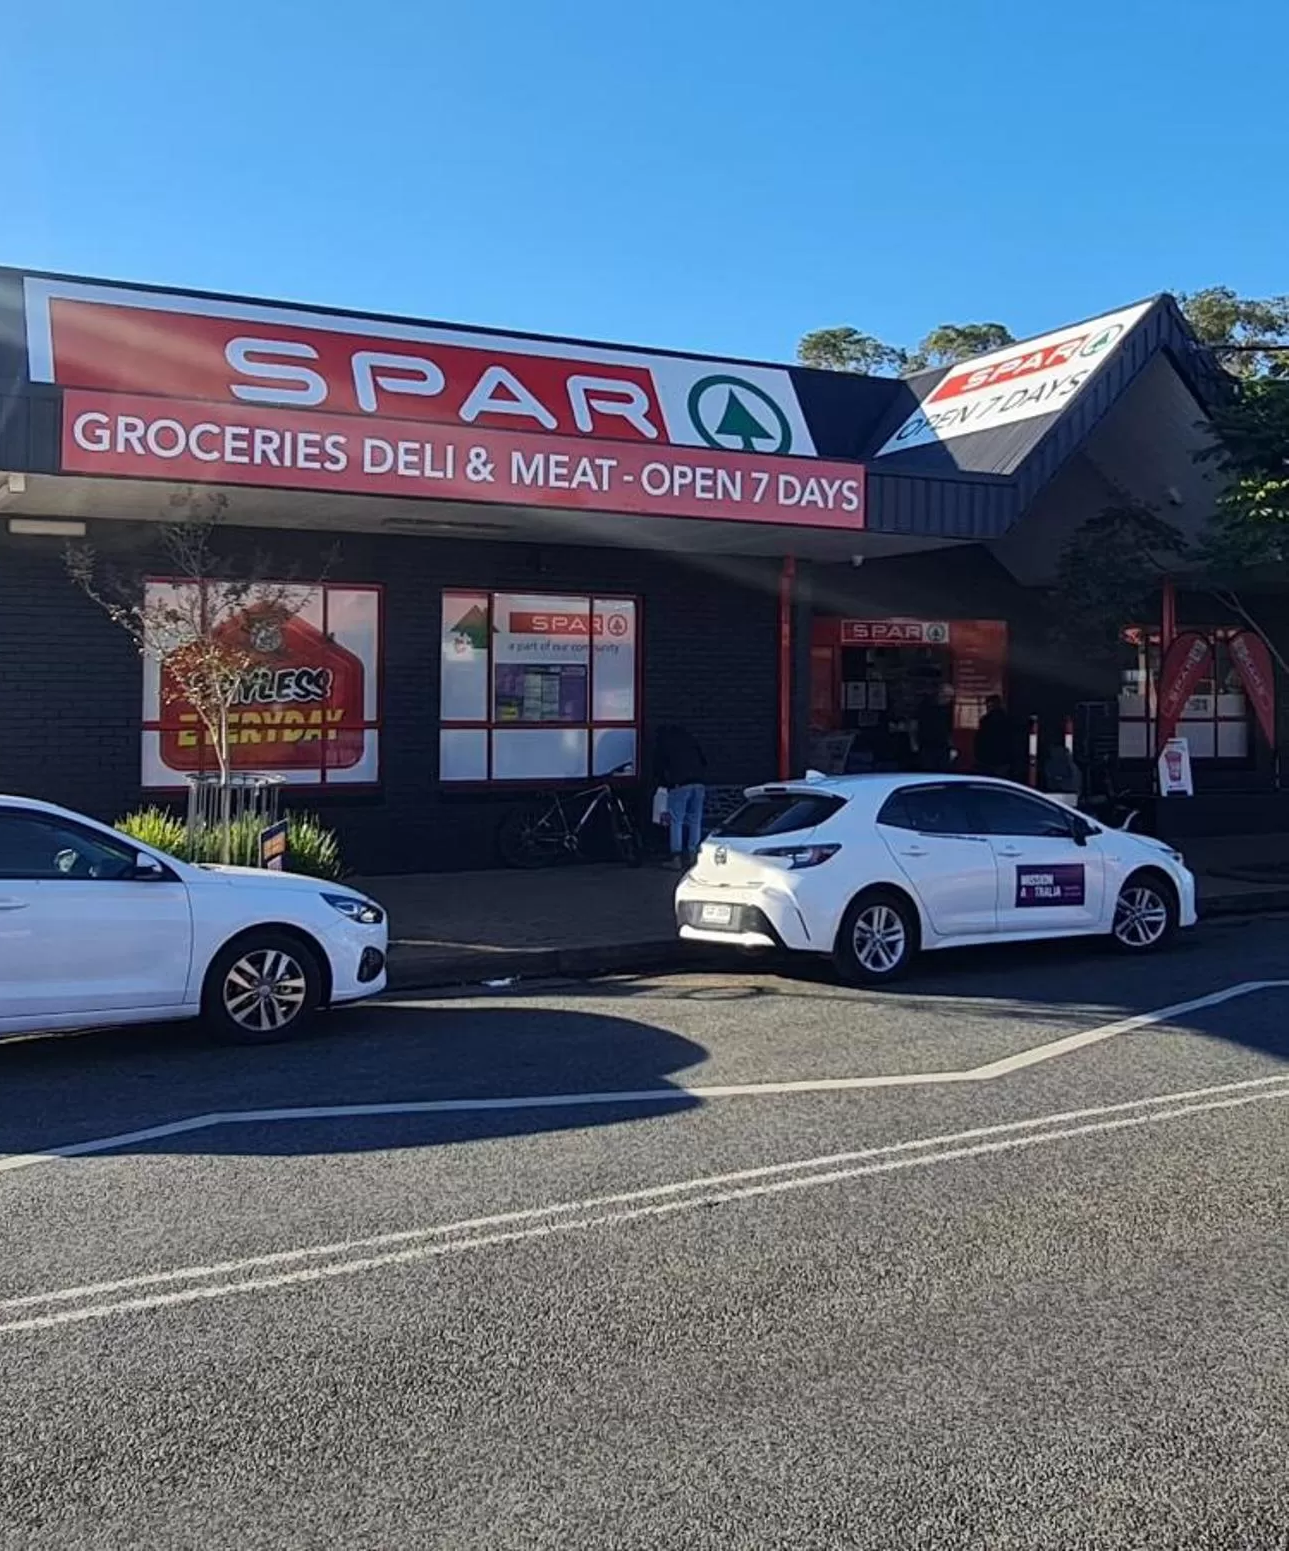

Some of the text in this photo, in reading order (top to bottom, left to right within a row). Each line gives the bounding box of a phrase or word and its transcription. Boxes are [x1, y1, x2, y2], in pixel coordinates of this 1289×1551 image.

[963, 338, 1084, 390] SPAR
[225, 336, 659, 440] SPAR
[896, 369, 1090, 441] OPEN 7 DAYS
[72, 411, 348, 471] GROCERIES
[362, 438, 454, 479] DELI
[465, 445, 495, 482] &
[511, 450, 617, 491] MEAT
[640, 462, 742, 502] OPEN
[750, 470, 770, 502] 7
[778, 475, 860, 511] DAYS
[532, 616, 602, 632] SPAR
[853, 624, 921, 638] SPAR
[517, 642, 539, 653] part
[191, 665, 333, 705] YLESS
